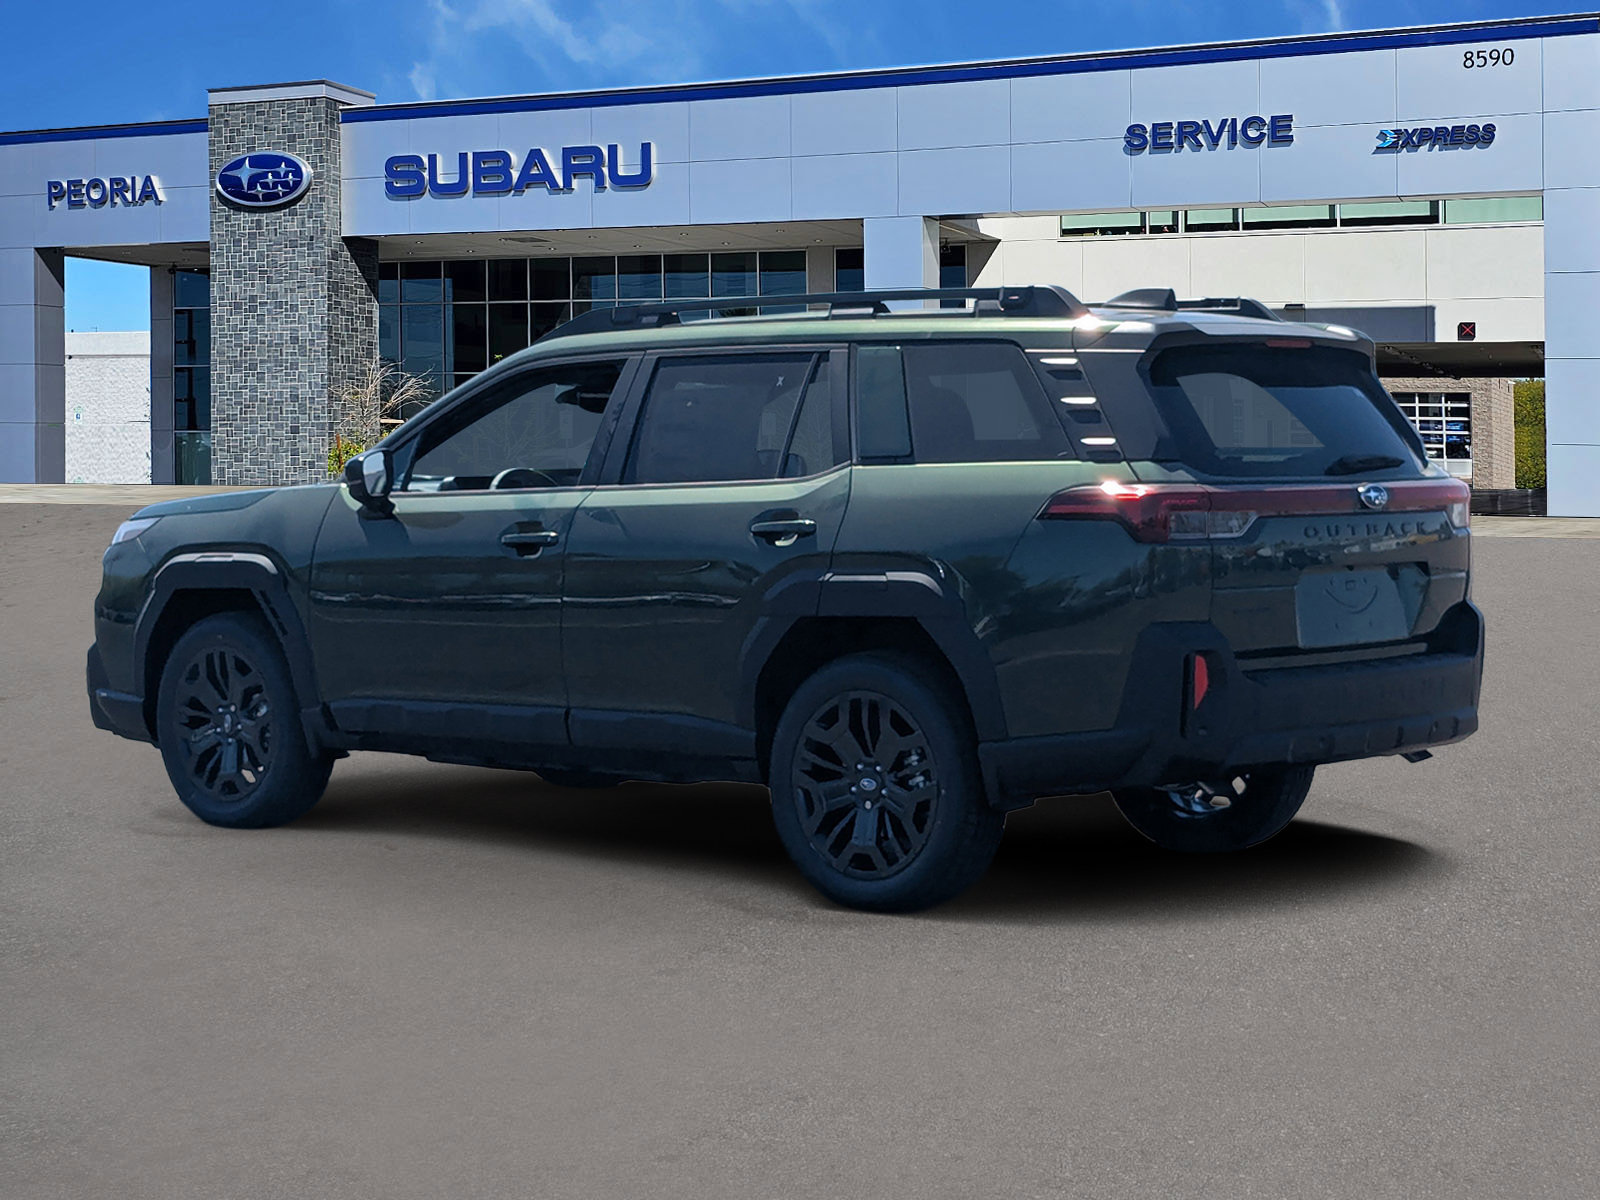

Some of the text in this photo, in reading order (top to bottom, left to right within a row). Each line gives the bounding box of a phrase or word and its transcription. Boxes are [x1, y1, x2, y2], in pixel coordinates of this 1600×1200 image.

[1463, 48, 1514, 69] 8590
[1125, 114, 1293, 151] SERVICE
[1376, 122, 1496, 151] EXPRESS
[385, 142, 652, 200] SUBARU
[48, 175, 161, 208] PEORIA
[1303, 520, 1426, 539] OUTBACK
